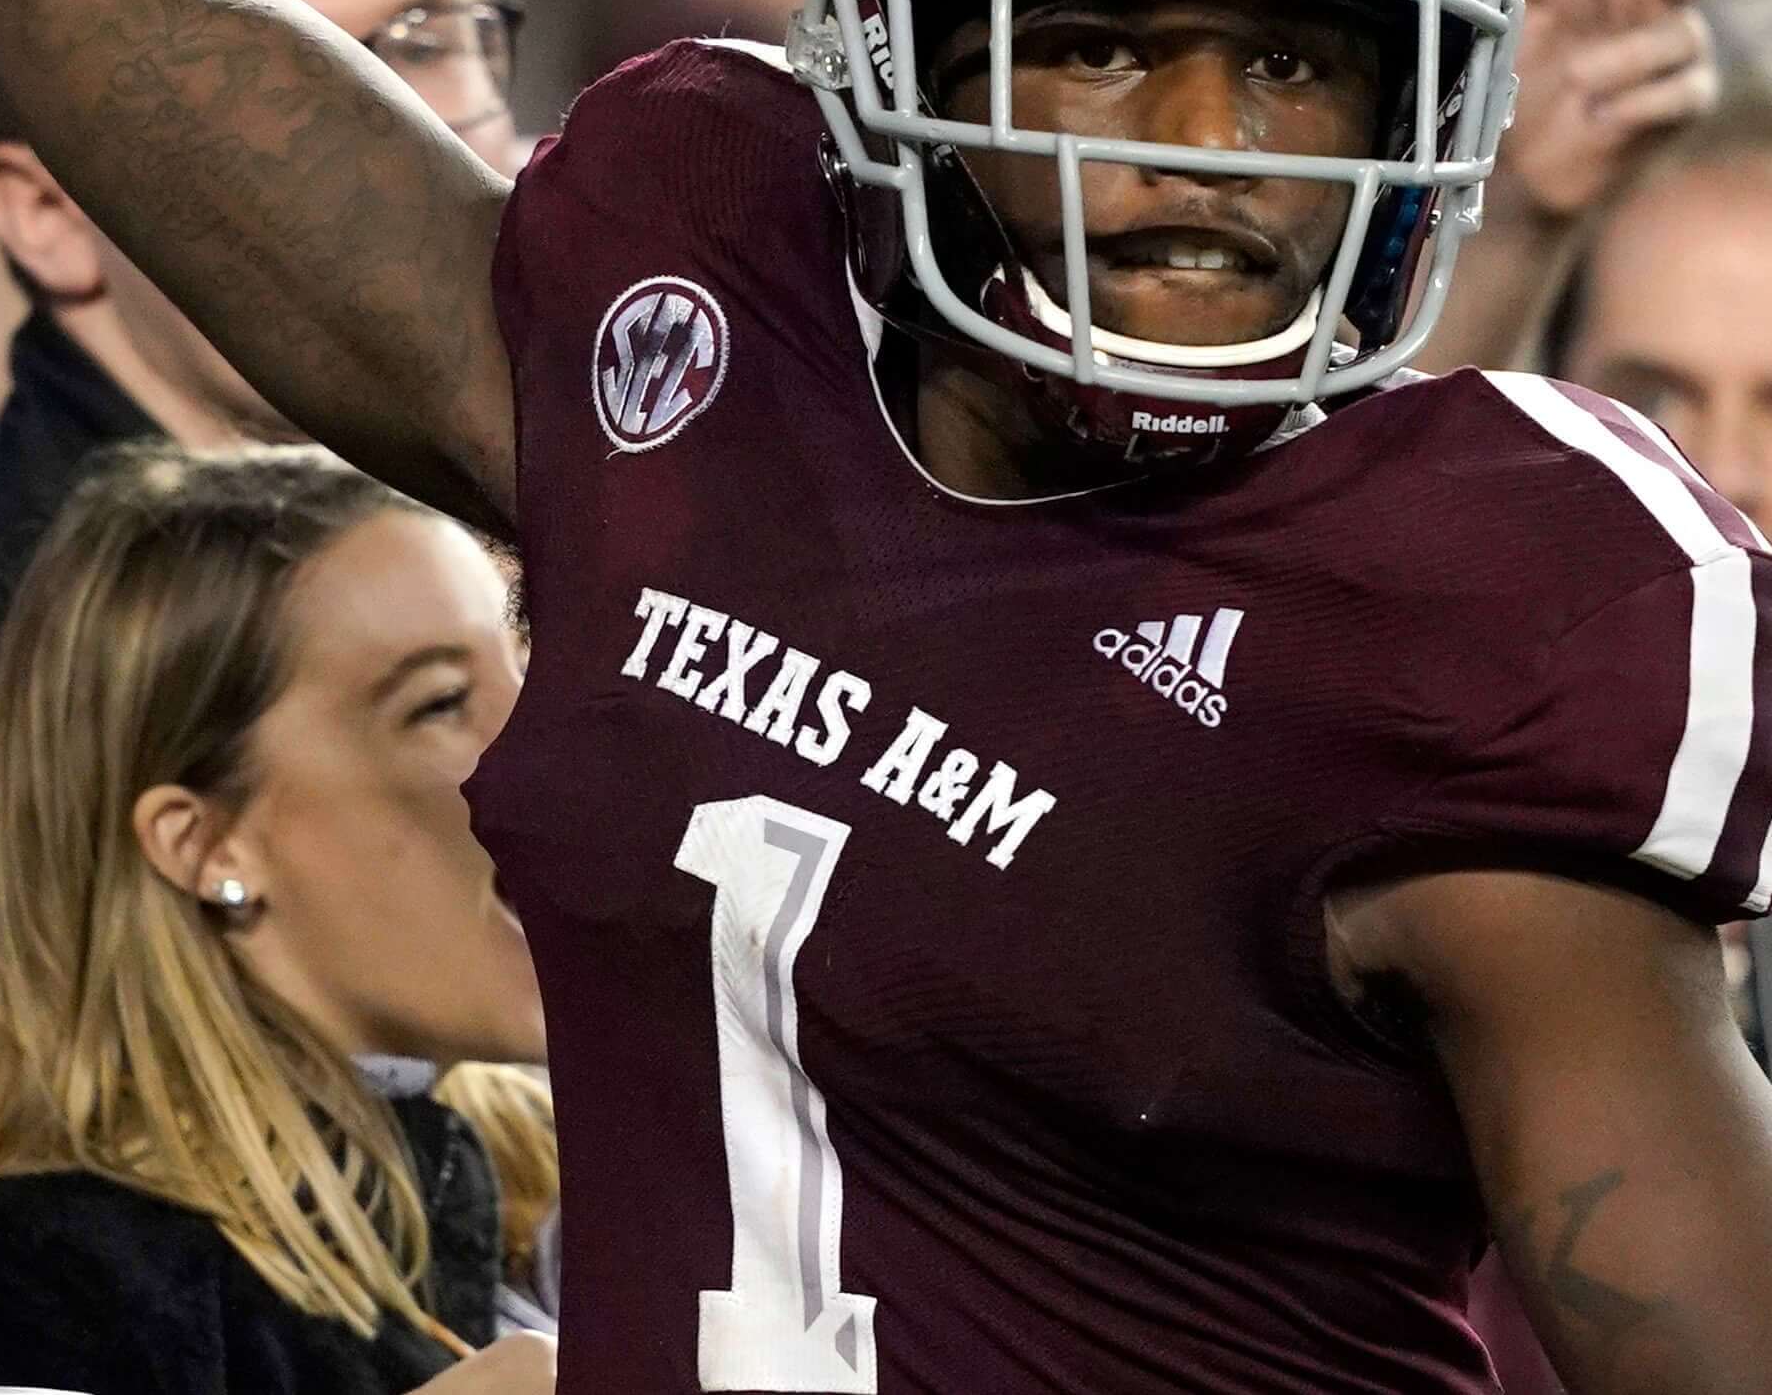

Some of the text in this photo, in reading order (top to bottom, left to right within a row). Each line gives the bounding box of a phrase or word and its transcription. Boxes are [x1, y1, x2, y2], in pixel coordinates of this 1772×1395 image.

[601, 291, 715, 436] SEC
[620, 586, 1058, 872] TEXAS A&M
[1092, 627, 1229, 728] adidas
[672, 793, 878, 1395] 1
